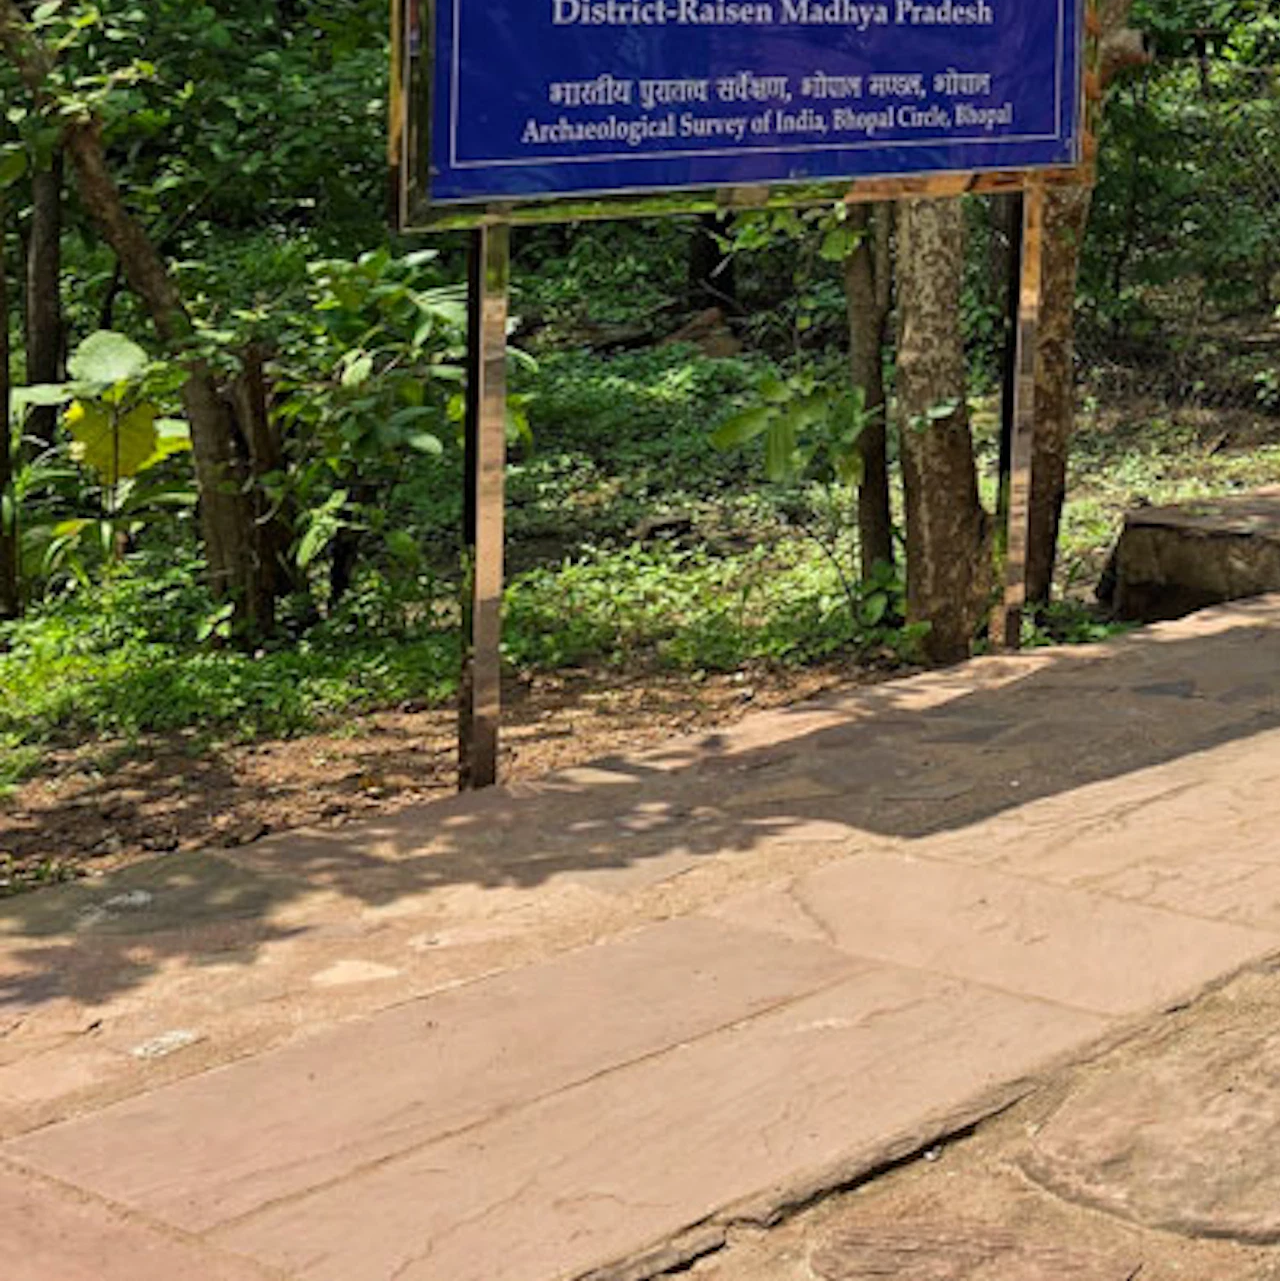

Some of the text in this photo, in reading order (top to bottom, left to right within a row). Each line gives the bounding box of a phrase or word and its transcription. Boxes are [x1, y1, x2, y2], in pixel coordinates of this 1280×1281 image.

[550, 73, 633, 106] भारतीय
[521, 112, 676, 146] Archaeological
[680, 112, 749, 142] Survey
[751, 109, 774, 134] of
[775, 108, 829, 135] India,
[832, 105, 895, 137] Bhopal
[955, 101, 1014, 131] Bhopal
